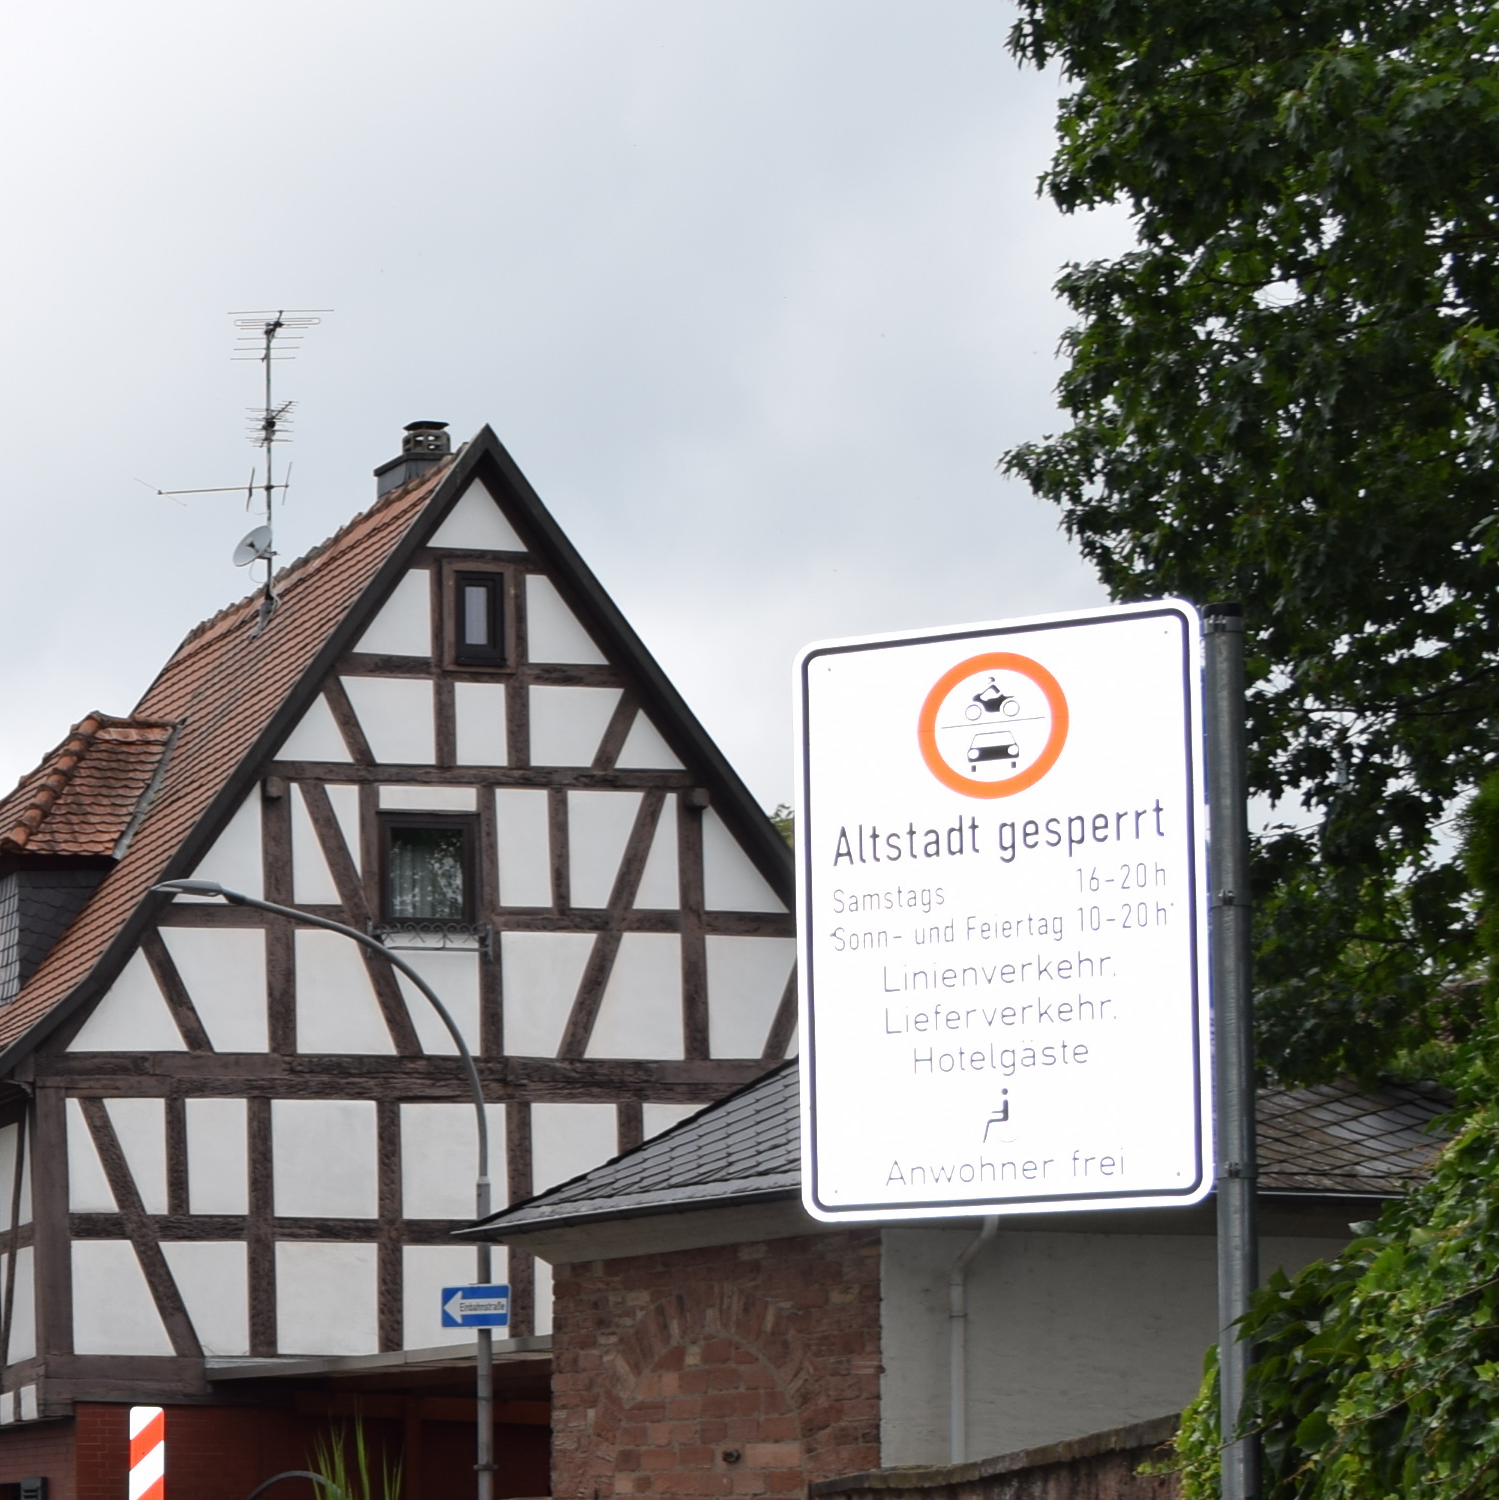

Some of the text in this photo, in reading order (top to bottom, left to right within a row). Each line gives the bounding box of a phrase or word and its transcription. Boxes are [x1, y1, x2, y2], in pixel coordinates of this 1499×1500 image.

[832, 798, 1165, 867] Altstadt gesperrt
[832, 886, 945, 914] Samstags
[832, 926, 903, 952] Sonn-
[914, 917, 955, 945] und
[966, 912, 1064, 942] Feiertag
[913, 1039, 1089, 1076] Hotelgäste
[885, 1147, 1124, 1186] Anwohner frei
